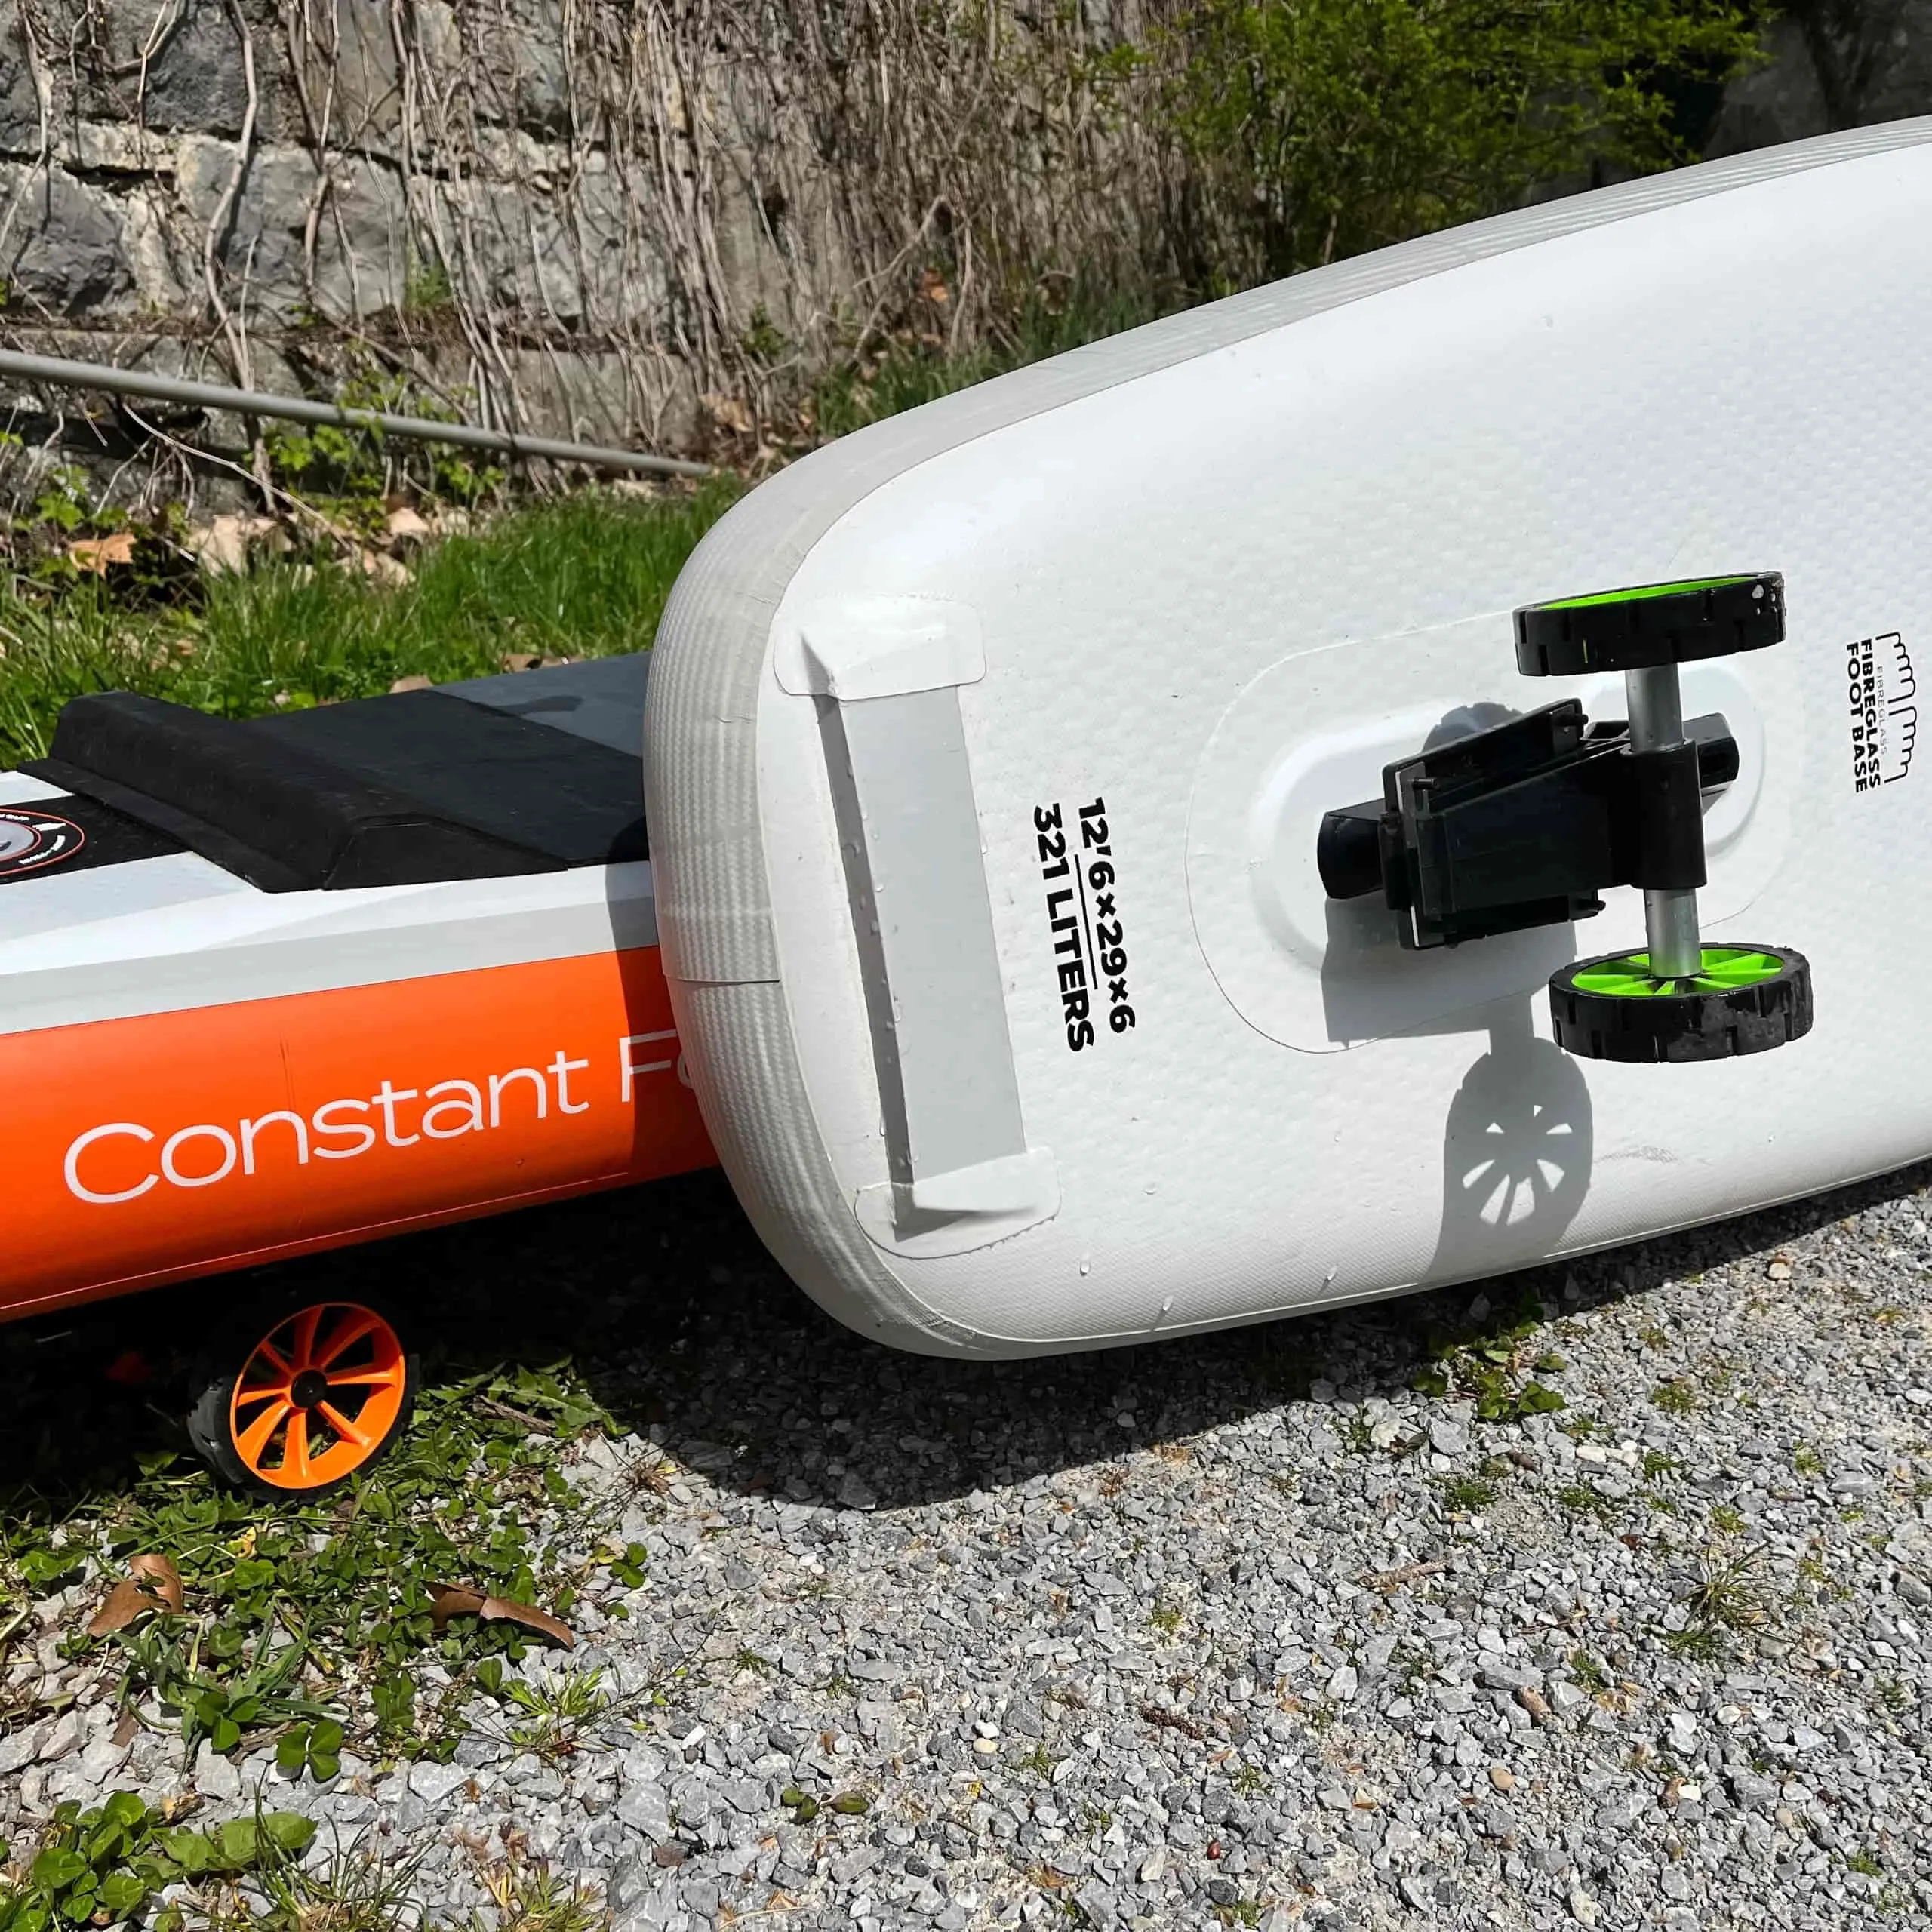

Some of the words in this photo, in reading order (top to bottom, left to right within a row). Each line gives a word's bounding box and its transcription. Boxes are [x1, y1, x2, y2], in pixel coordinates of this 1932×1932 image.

[1847, 642, 1863, 717] FOOT
[1860, 638, 1881, 789] FIBREGLASS
[1876, 666, 1888, 755] FIBREGLASS
[1851, 726, 1868, 793] BASE
[1034, 803, 1069, 880] 321
[1047, 888, 1094, 1052] LITERS
[63, 1051, 589, 1204] Constant
